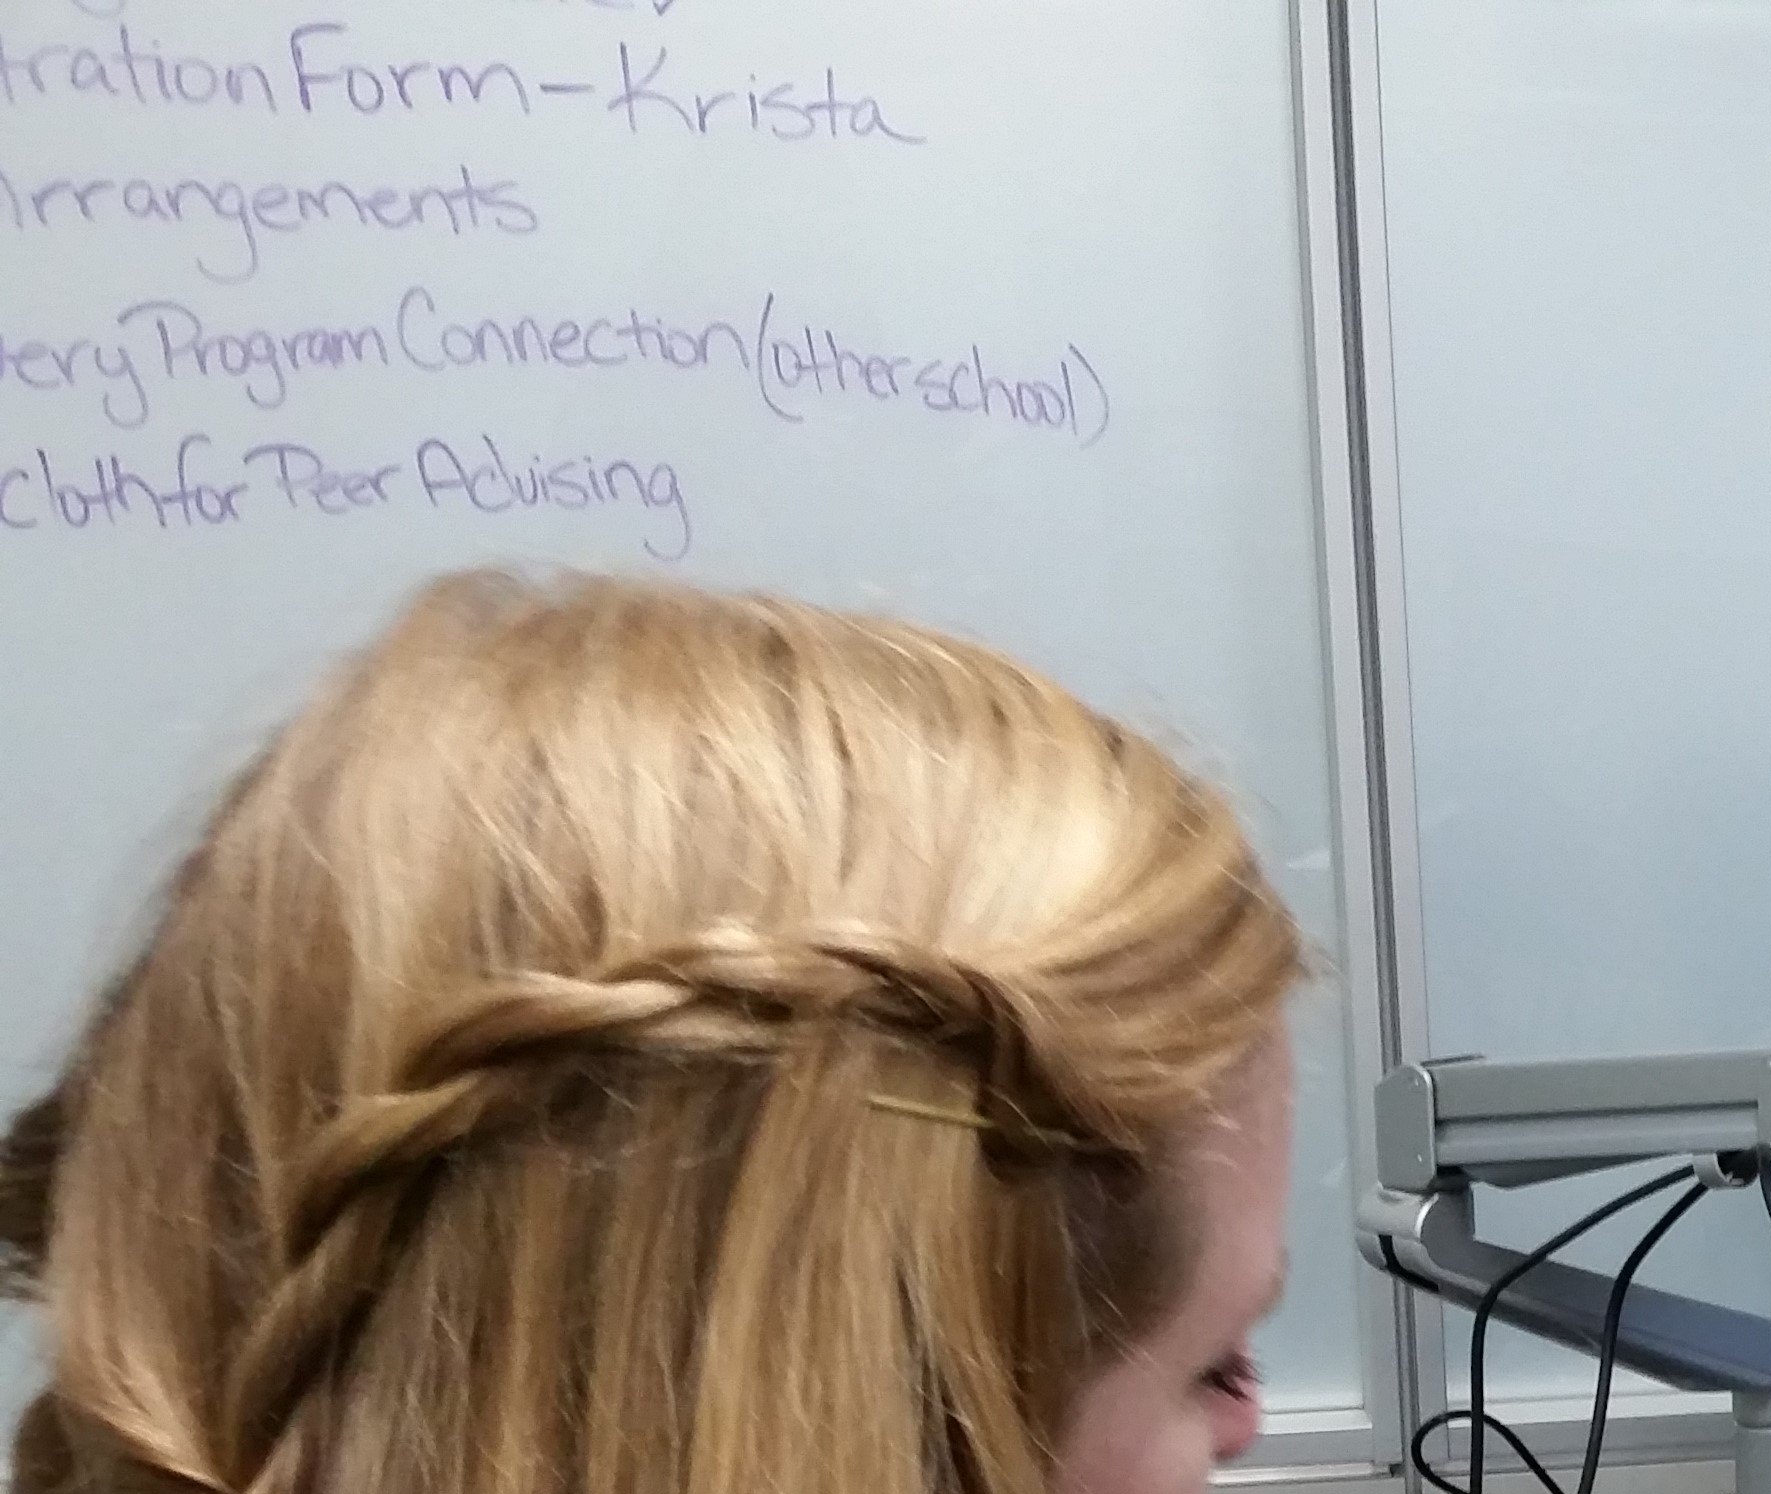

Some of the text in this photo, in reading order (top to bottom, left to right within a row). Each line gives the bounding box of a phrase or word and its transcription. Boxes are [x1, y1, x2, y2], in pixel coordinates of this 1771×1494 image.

[607, 41, 927, 145] Krista
[0, 333, 148, 429] ery
[117, 301, 389, 410] Program
[398, 286, 751, 374] Connection
[242, 442, 402, 516] Peer
[415, 432, 692, 563] Advising
